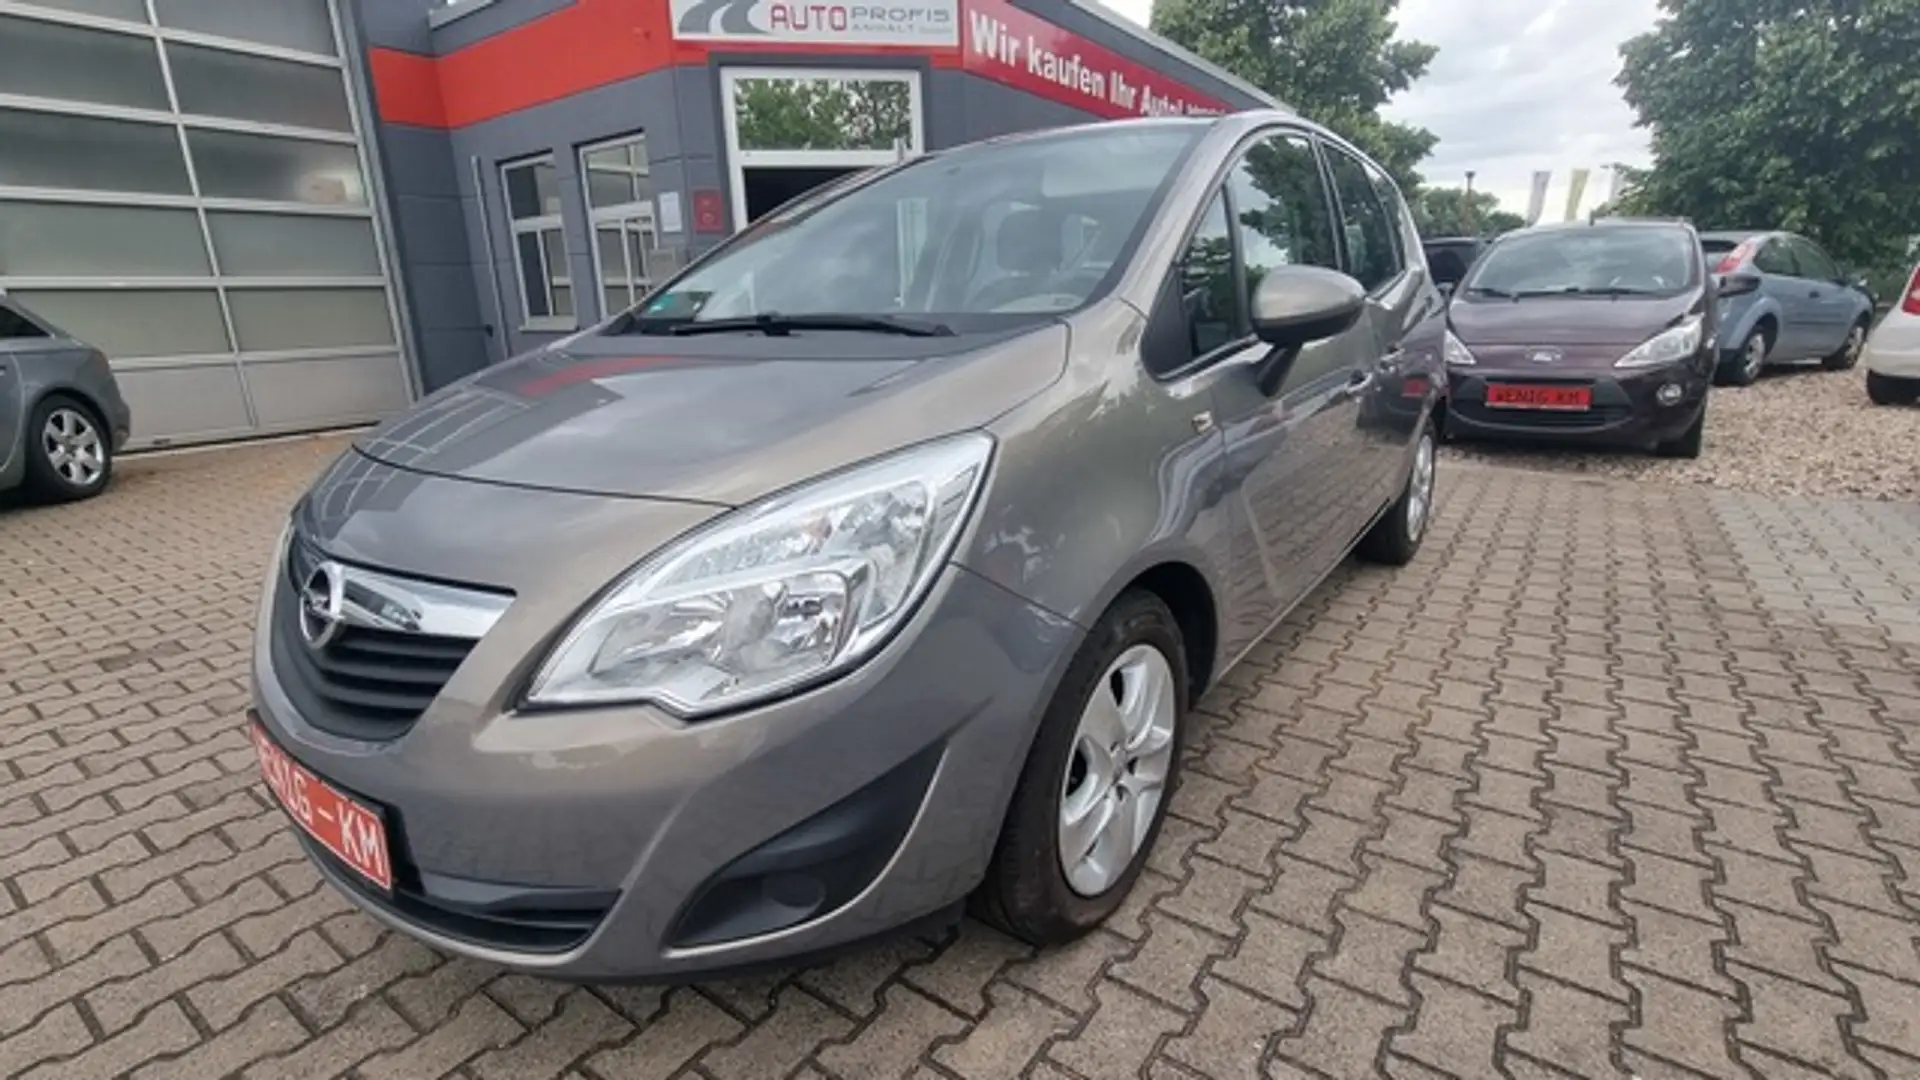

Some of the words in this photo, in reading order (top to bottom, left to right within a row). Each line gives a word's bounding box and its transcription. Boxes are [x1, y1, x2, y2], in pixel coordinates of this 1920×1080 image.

[770, 4, 848, 32] AUTO
[850, 5, 951, 22] PROFIS
[969, 9, 1020, 67] Wir
[1027, 35, 1105, 100] kaufen
[1109, 70, 1136, 111] Ihr
